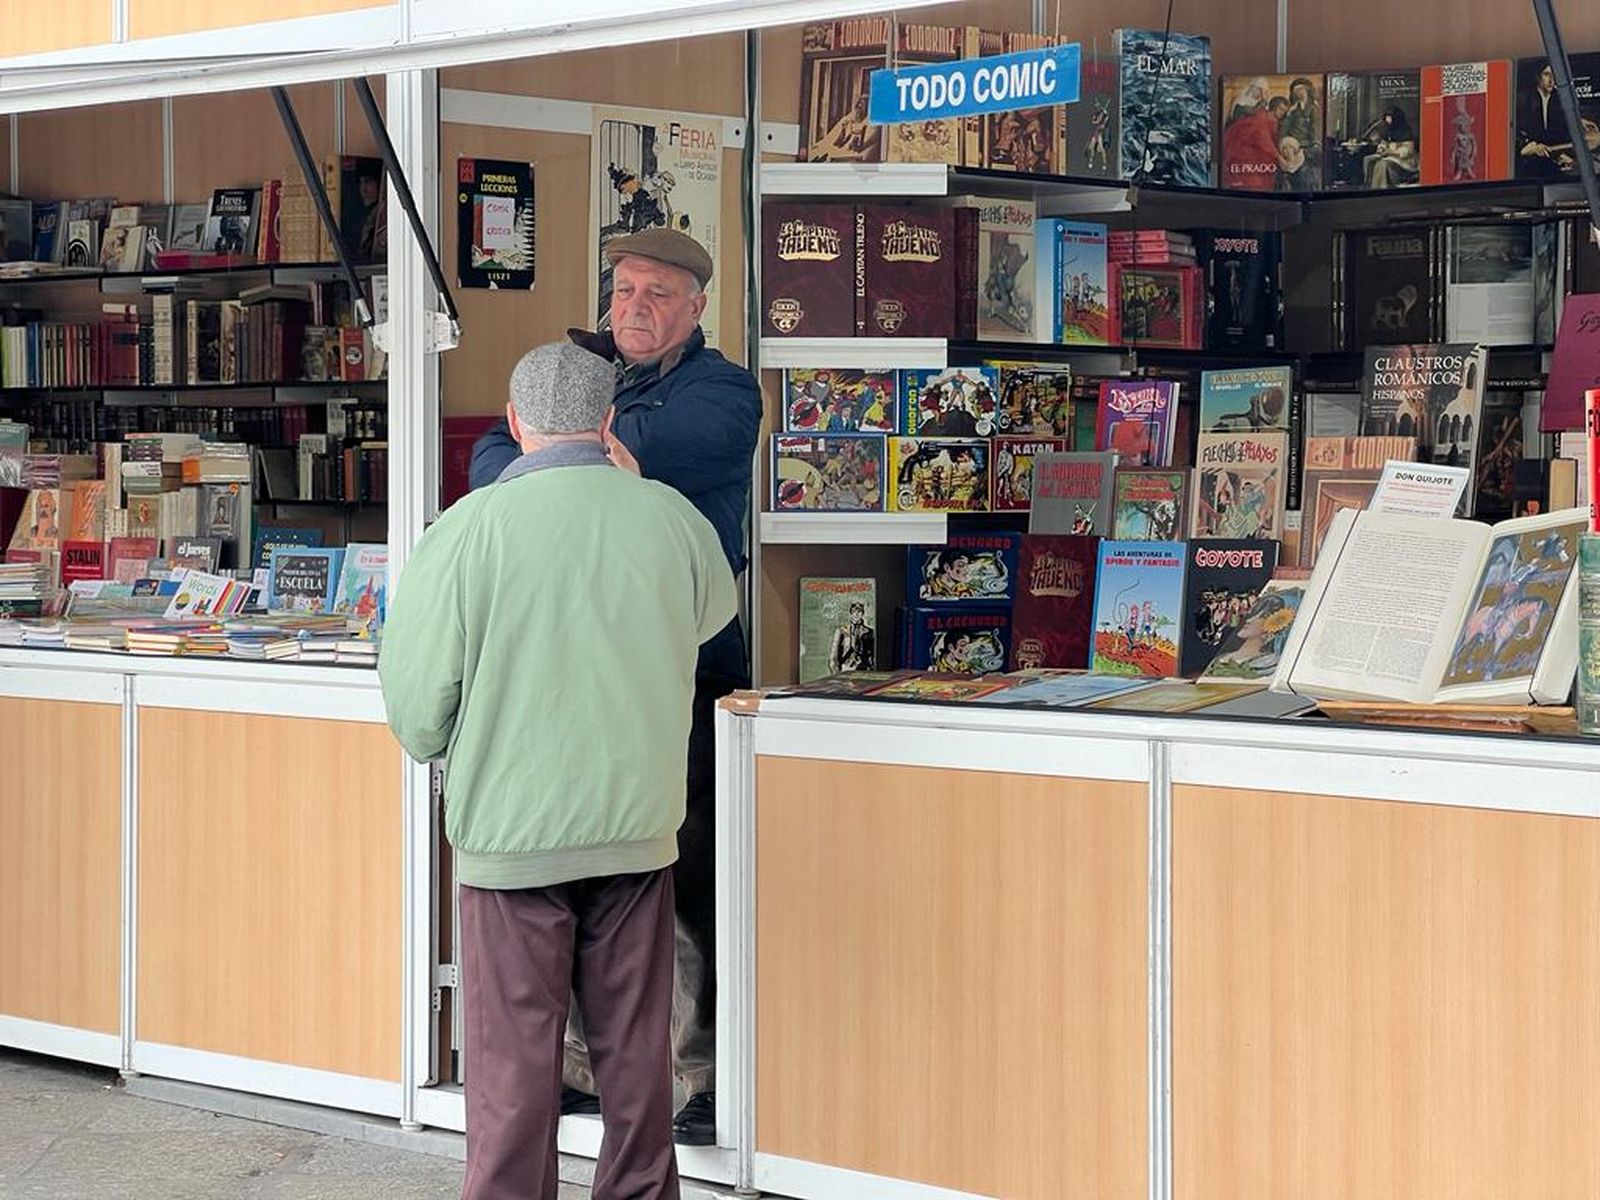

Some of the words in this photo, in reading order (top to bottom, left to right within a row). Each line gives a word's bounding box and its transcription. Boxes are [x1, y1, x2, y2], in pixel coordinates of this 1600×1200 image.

[905, 25, 956, 54] CODORNIZ
[1136, 54, 1158, 74] EL
[1160, 56, 1198, 76] MAR
[896, 73, 966, 112] TODO
[973, 58, 1057, 104] COMIC
[669, 123, 717, 150] FERIA
[1230, 163, 1240, 174] EL
[1242, 162, 1277, 174] PRADO
[482, 174, 517, 184] PRIMERAS
[481, 183, 518, 193] LECCIONES
[777, 235, 841, 260] TRUENO
[1374, 355, 1463, 373] CLAUSTROS
[1374, 371, 1462, 388] ROMÁNICOS
[1372, 388, 1426, 401] HISPANOS
[1395, 472, 1413, 482] DON
[1414, 474, 1454, 486] QUIJOTE
[66, 549, 101, 565] STALIN
[1196, 548, 1263, 568] COYOTE
[280, 576, 323, 590] ESCUELA
